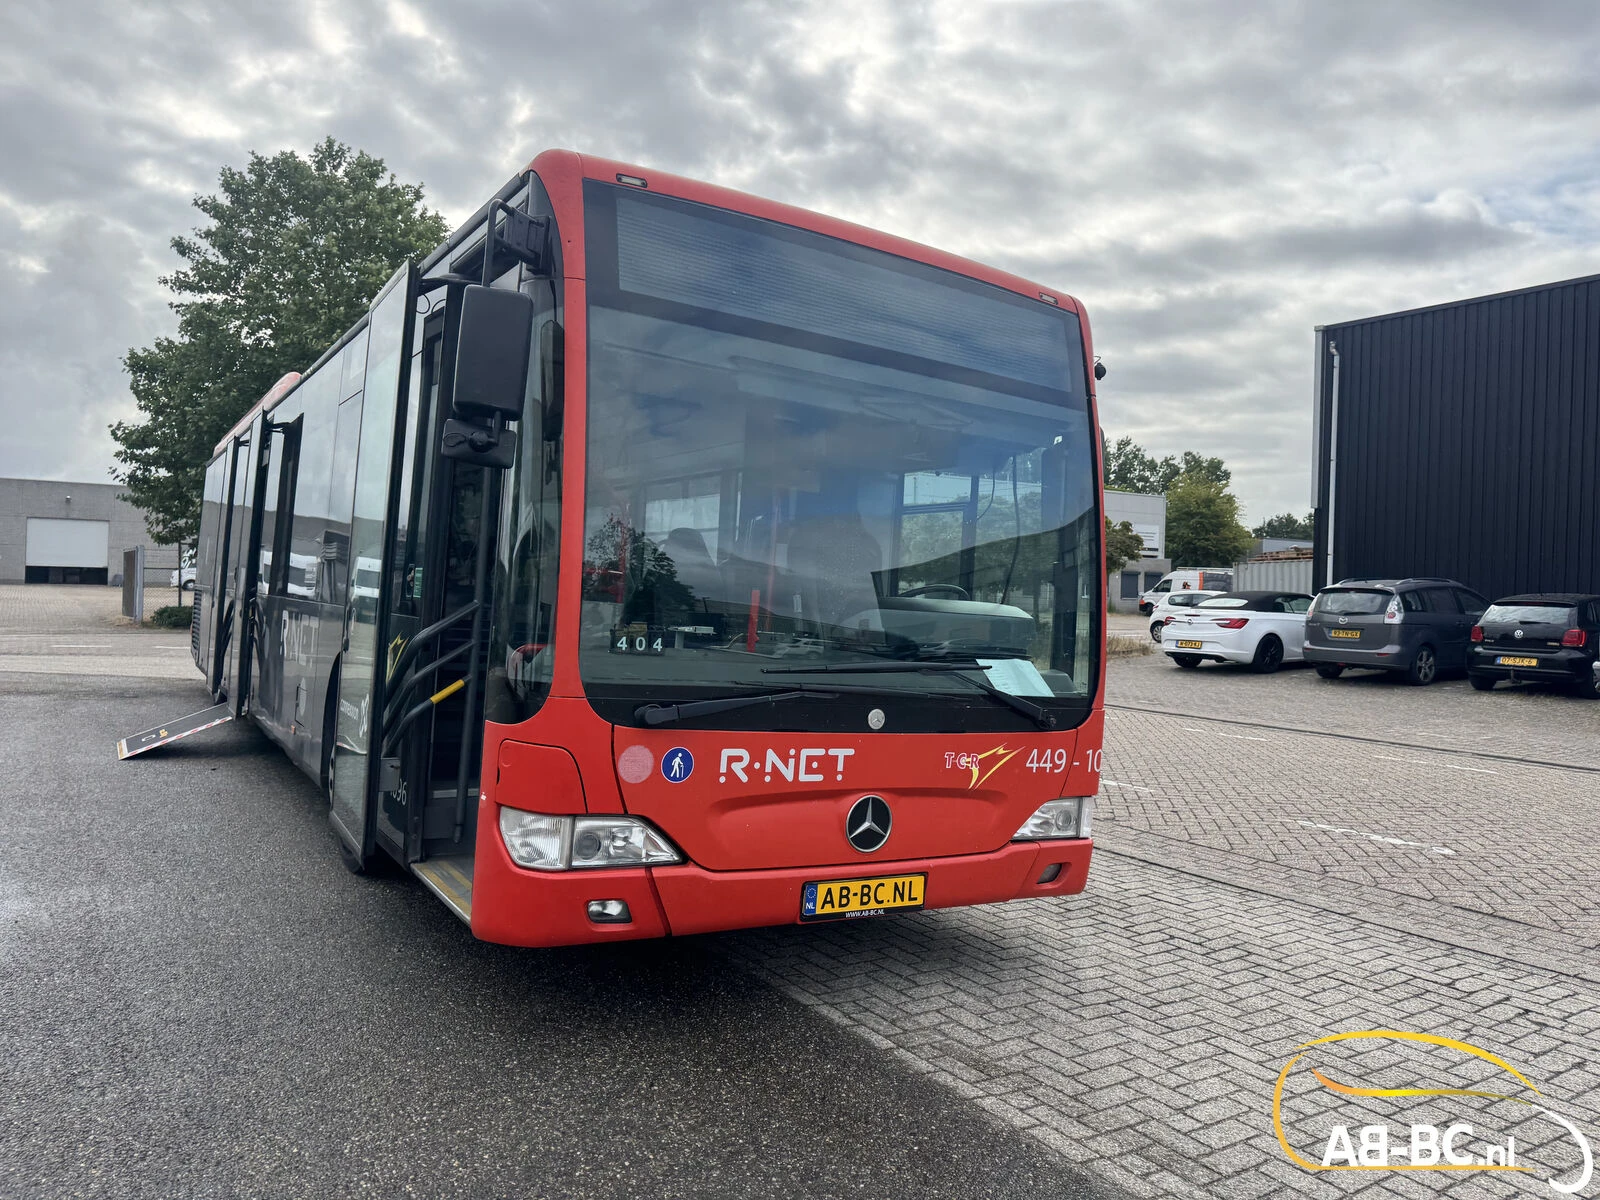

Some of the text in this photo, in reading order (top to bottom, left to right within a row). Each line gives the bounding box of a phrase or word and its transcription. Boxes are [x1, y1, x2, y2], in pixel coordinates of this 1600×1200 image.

[1501, 656, 1533, 665] 07-SJK-6
[1025, 749, 1067, 773] 449
[805, 880, 918, 910] NL AB-BC.NL
[845, 909, 885, 918] WWW.AB-BC.NL
